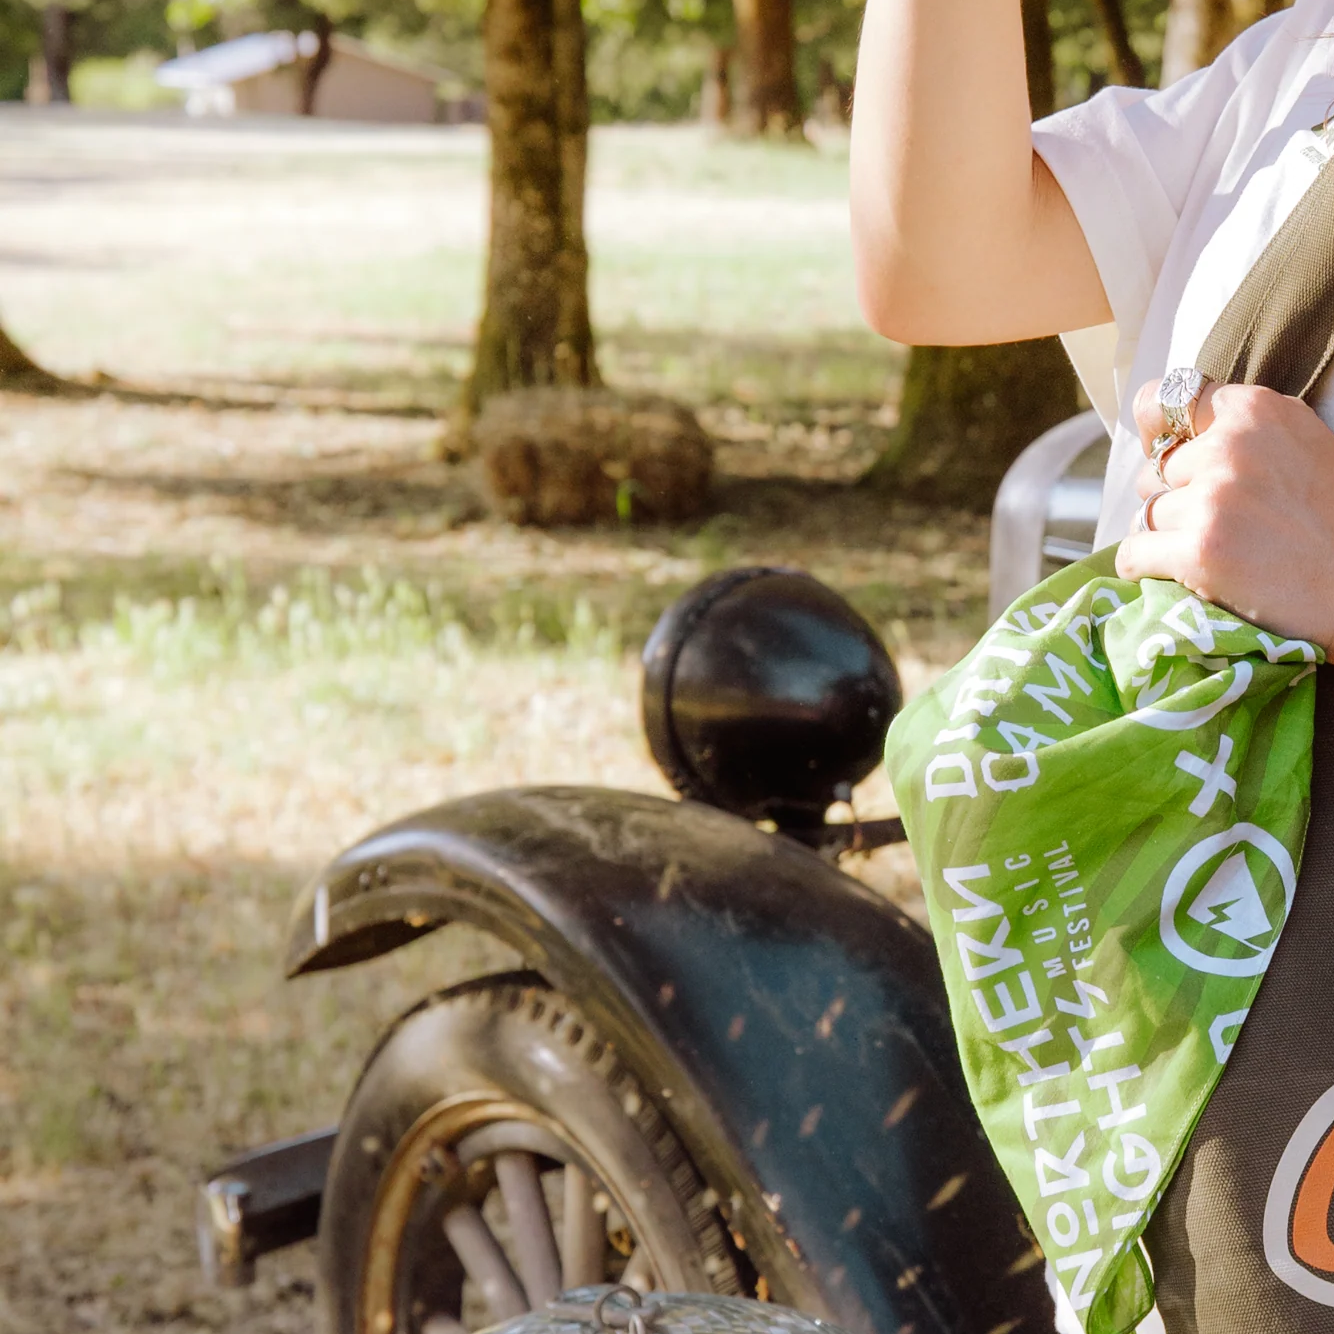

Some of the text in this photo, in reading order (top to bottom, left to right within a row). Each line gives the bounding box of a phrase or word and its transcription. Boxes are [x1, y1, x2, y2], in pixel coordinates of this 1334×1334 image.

[1004, 853, 1067, 979] MUSIC
[1043, 840, 1094, 972] FESTIVAL
[943, 864, 1103, 1311] NORTHERN
[1055, 979, 1163, 1255] IGHTS
